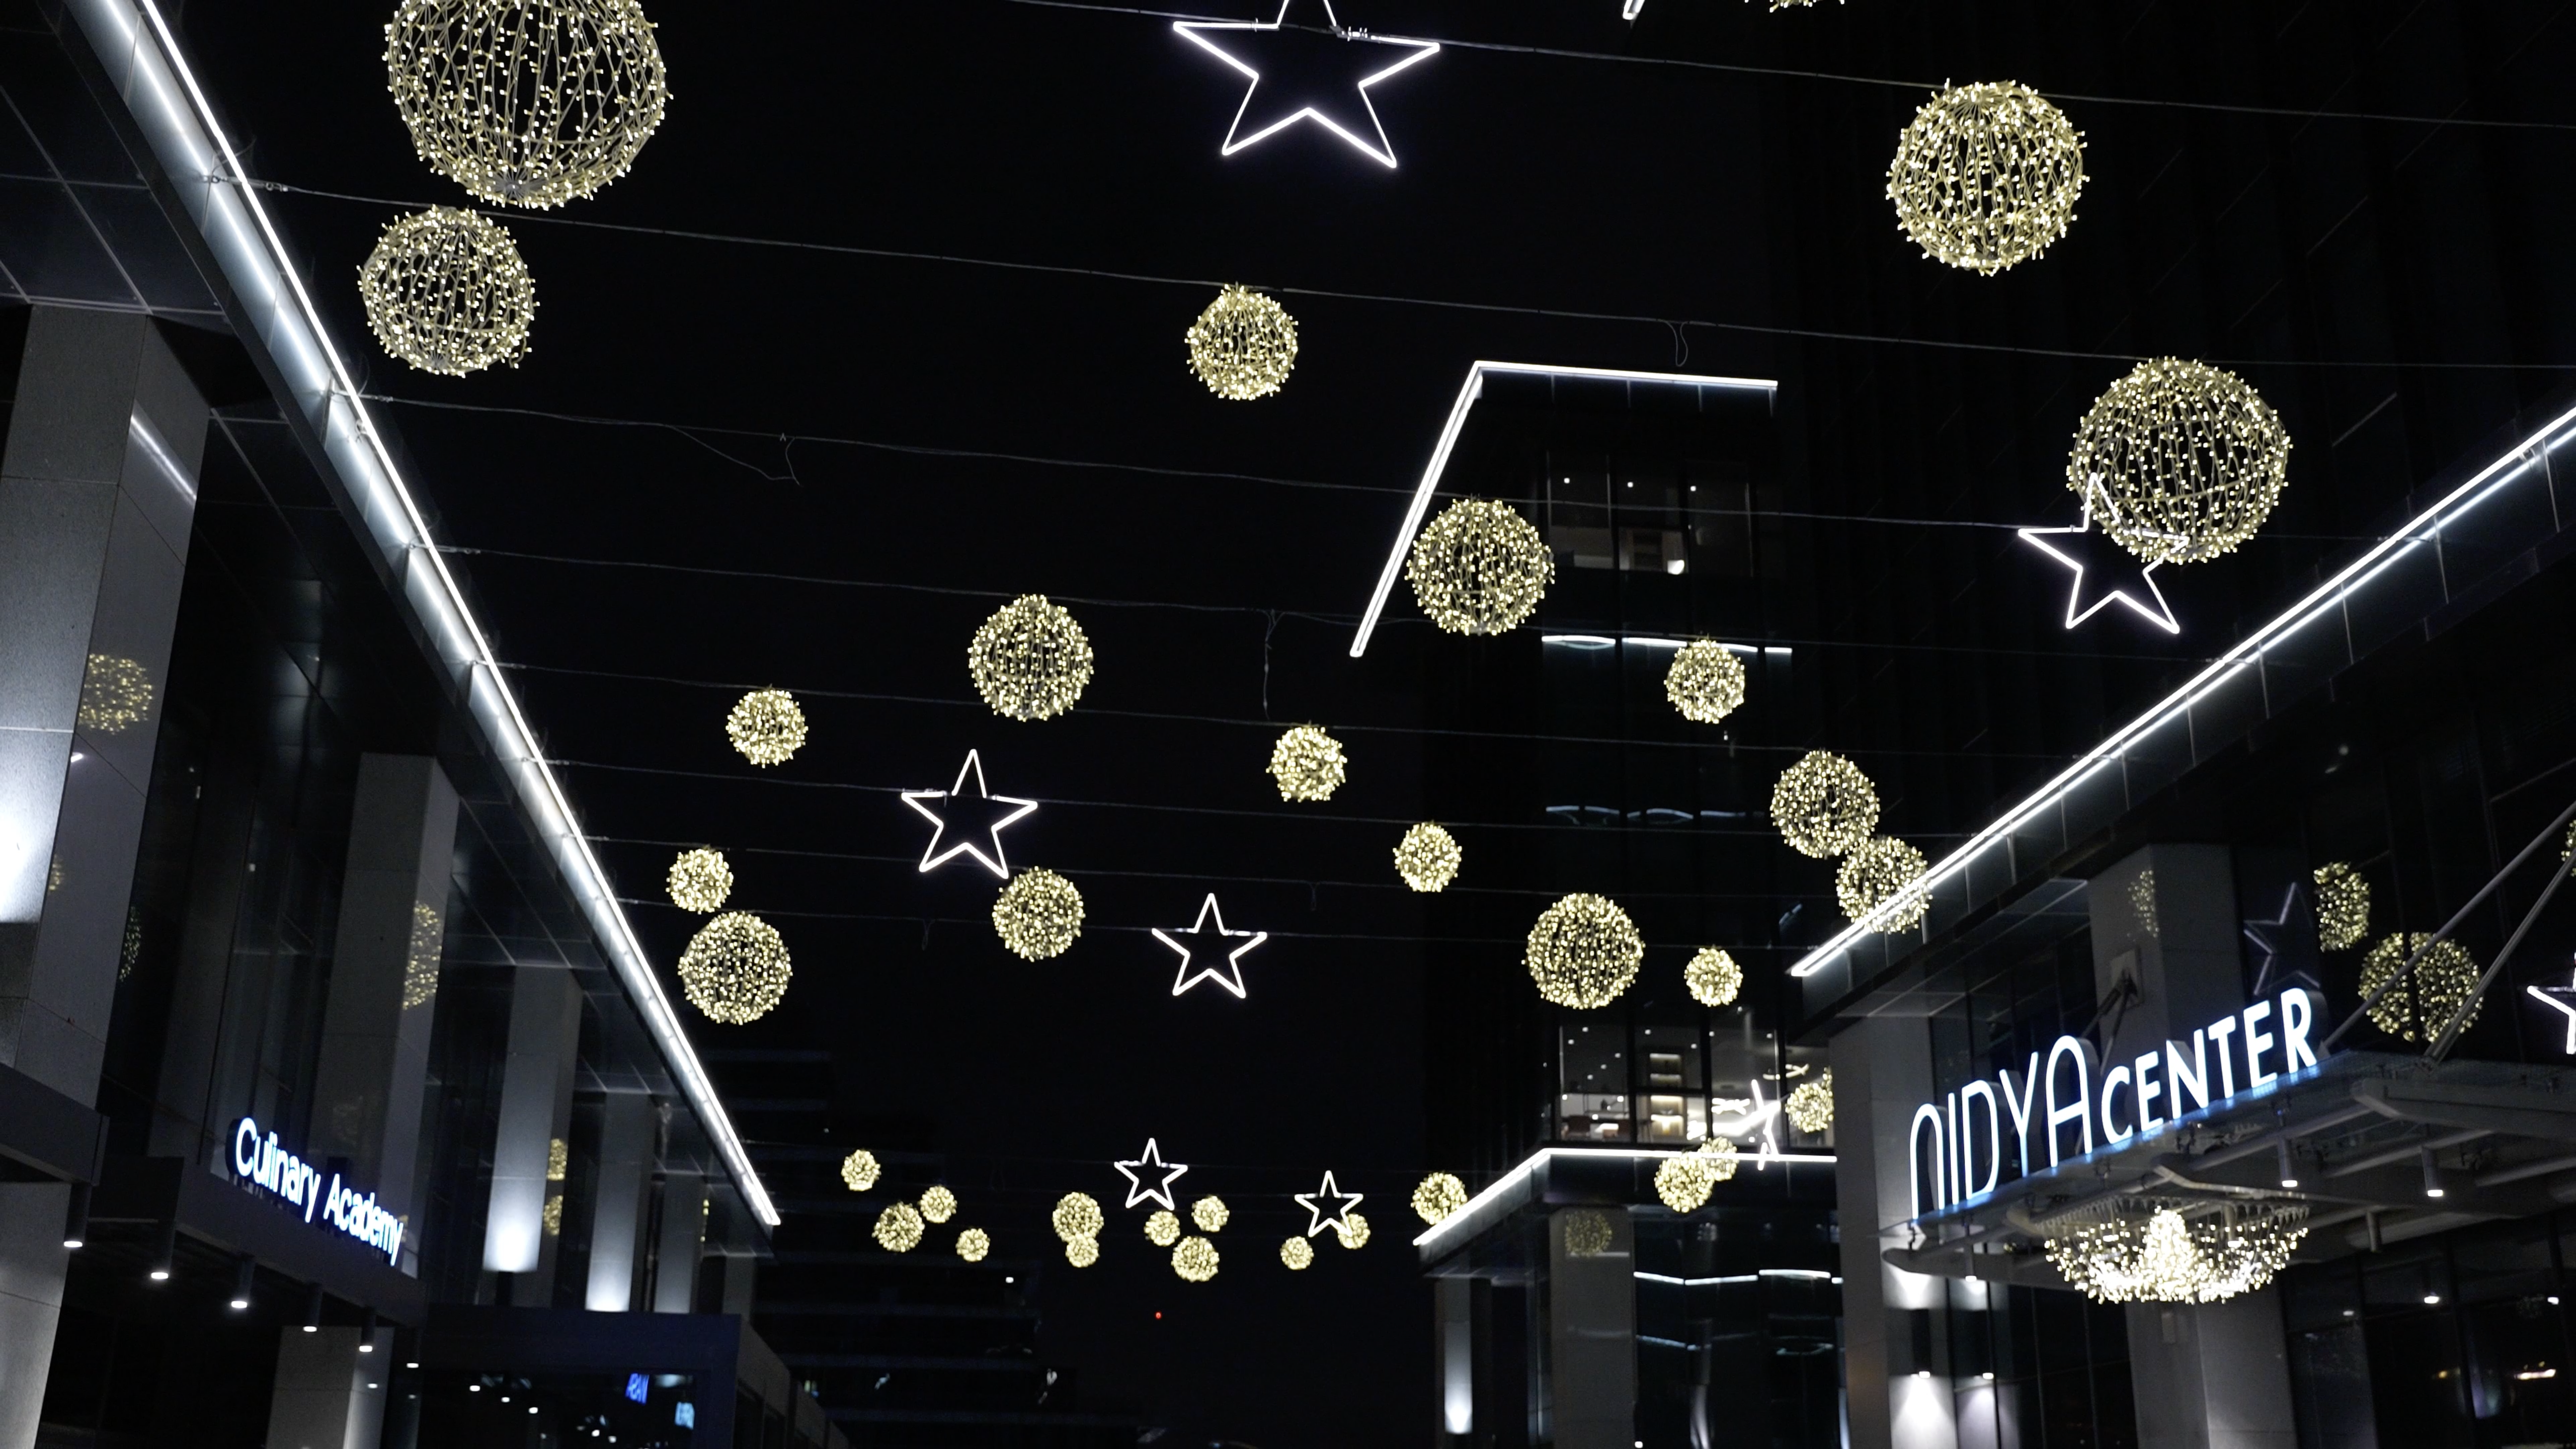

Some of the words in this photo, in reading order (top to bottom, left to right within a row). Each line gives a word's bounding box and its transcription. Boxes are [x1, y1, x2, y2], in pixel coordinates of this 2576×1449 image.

[2101, 988, 2316, 1144] CENTER
[236, 1117, 321, 1223] Culinary
[324, 1173, 403, 1266] Academy
